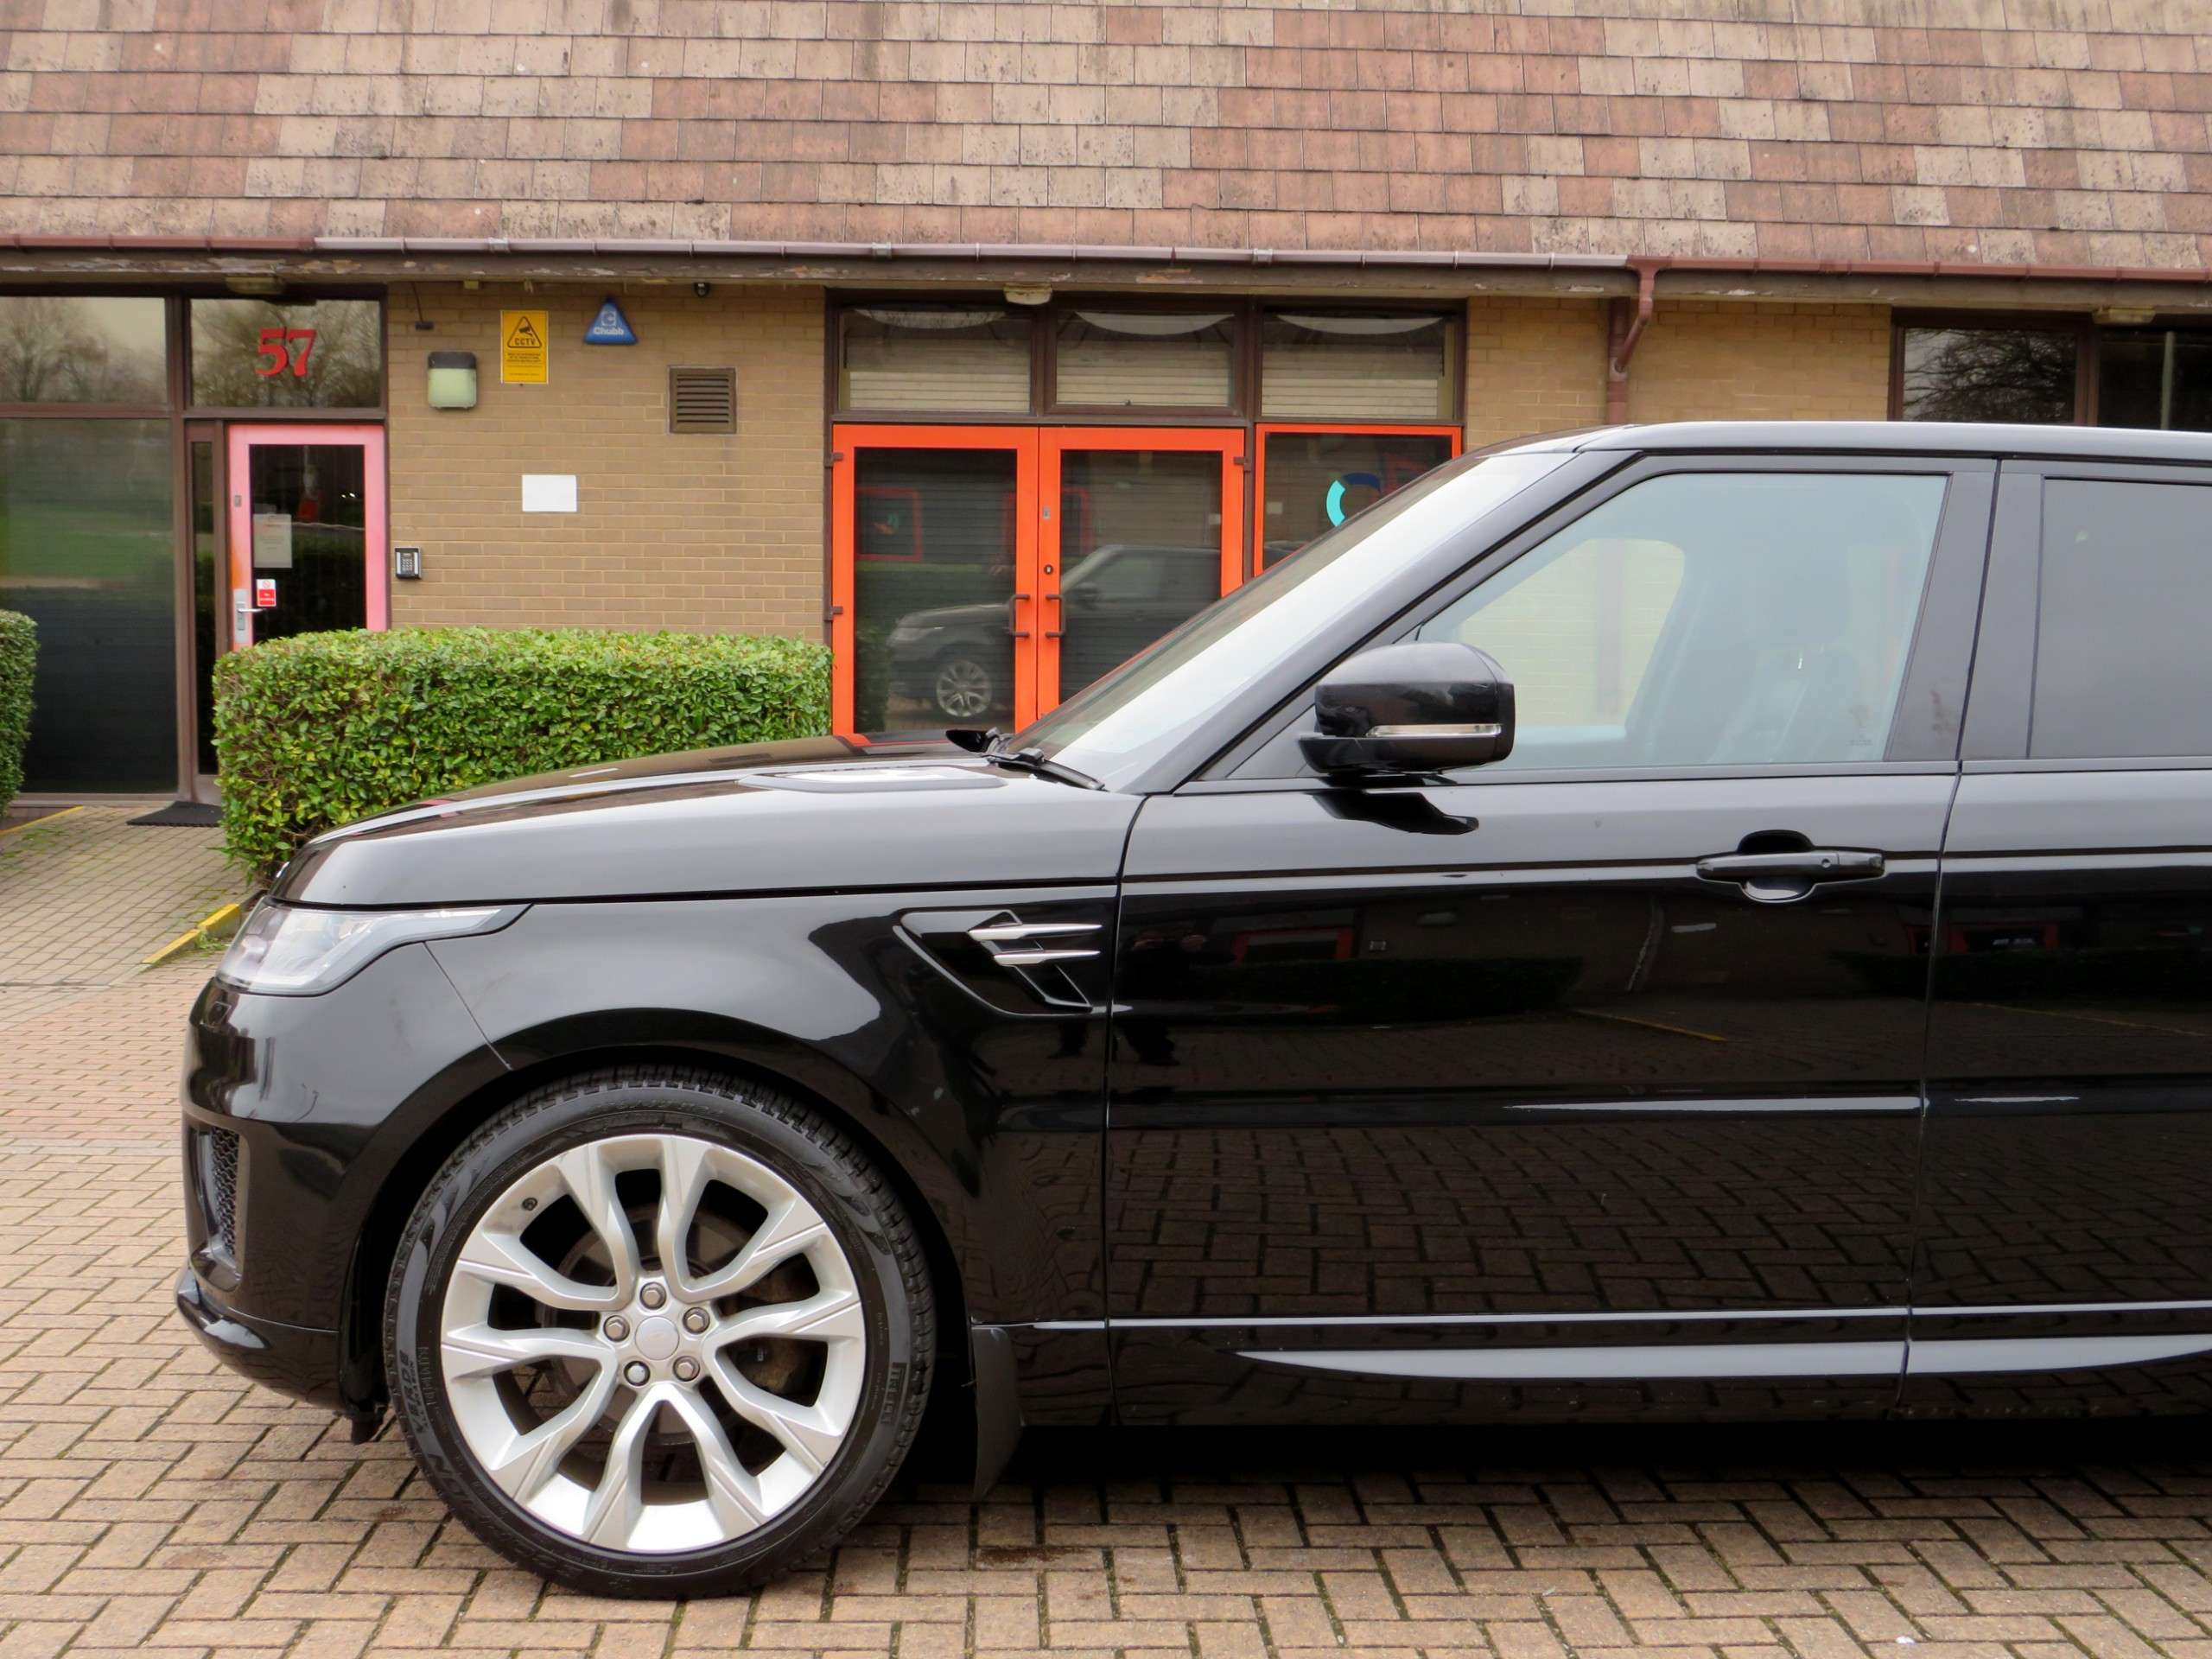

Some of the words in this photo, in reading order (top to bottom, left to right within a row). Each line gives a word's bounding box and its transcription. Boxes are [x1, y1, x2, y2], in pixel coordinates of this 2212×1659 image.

[255, 327, 317, 377] 57
[594, 327, 625, 336] Chubb
[398, 1349, 424, 1433] VERDE
